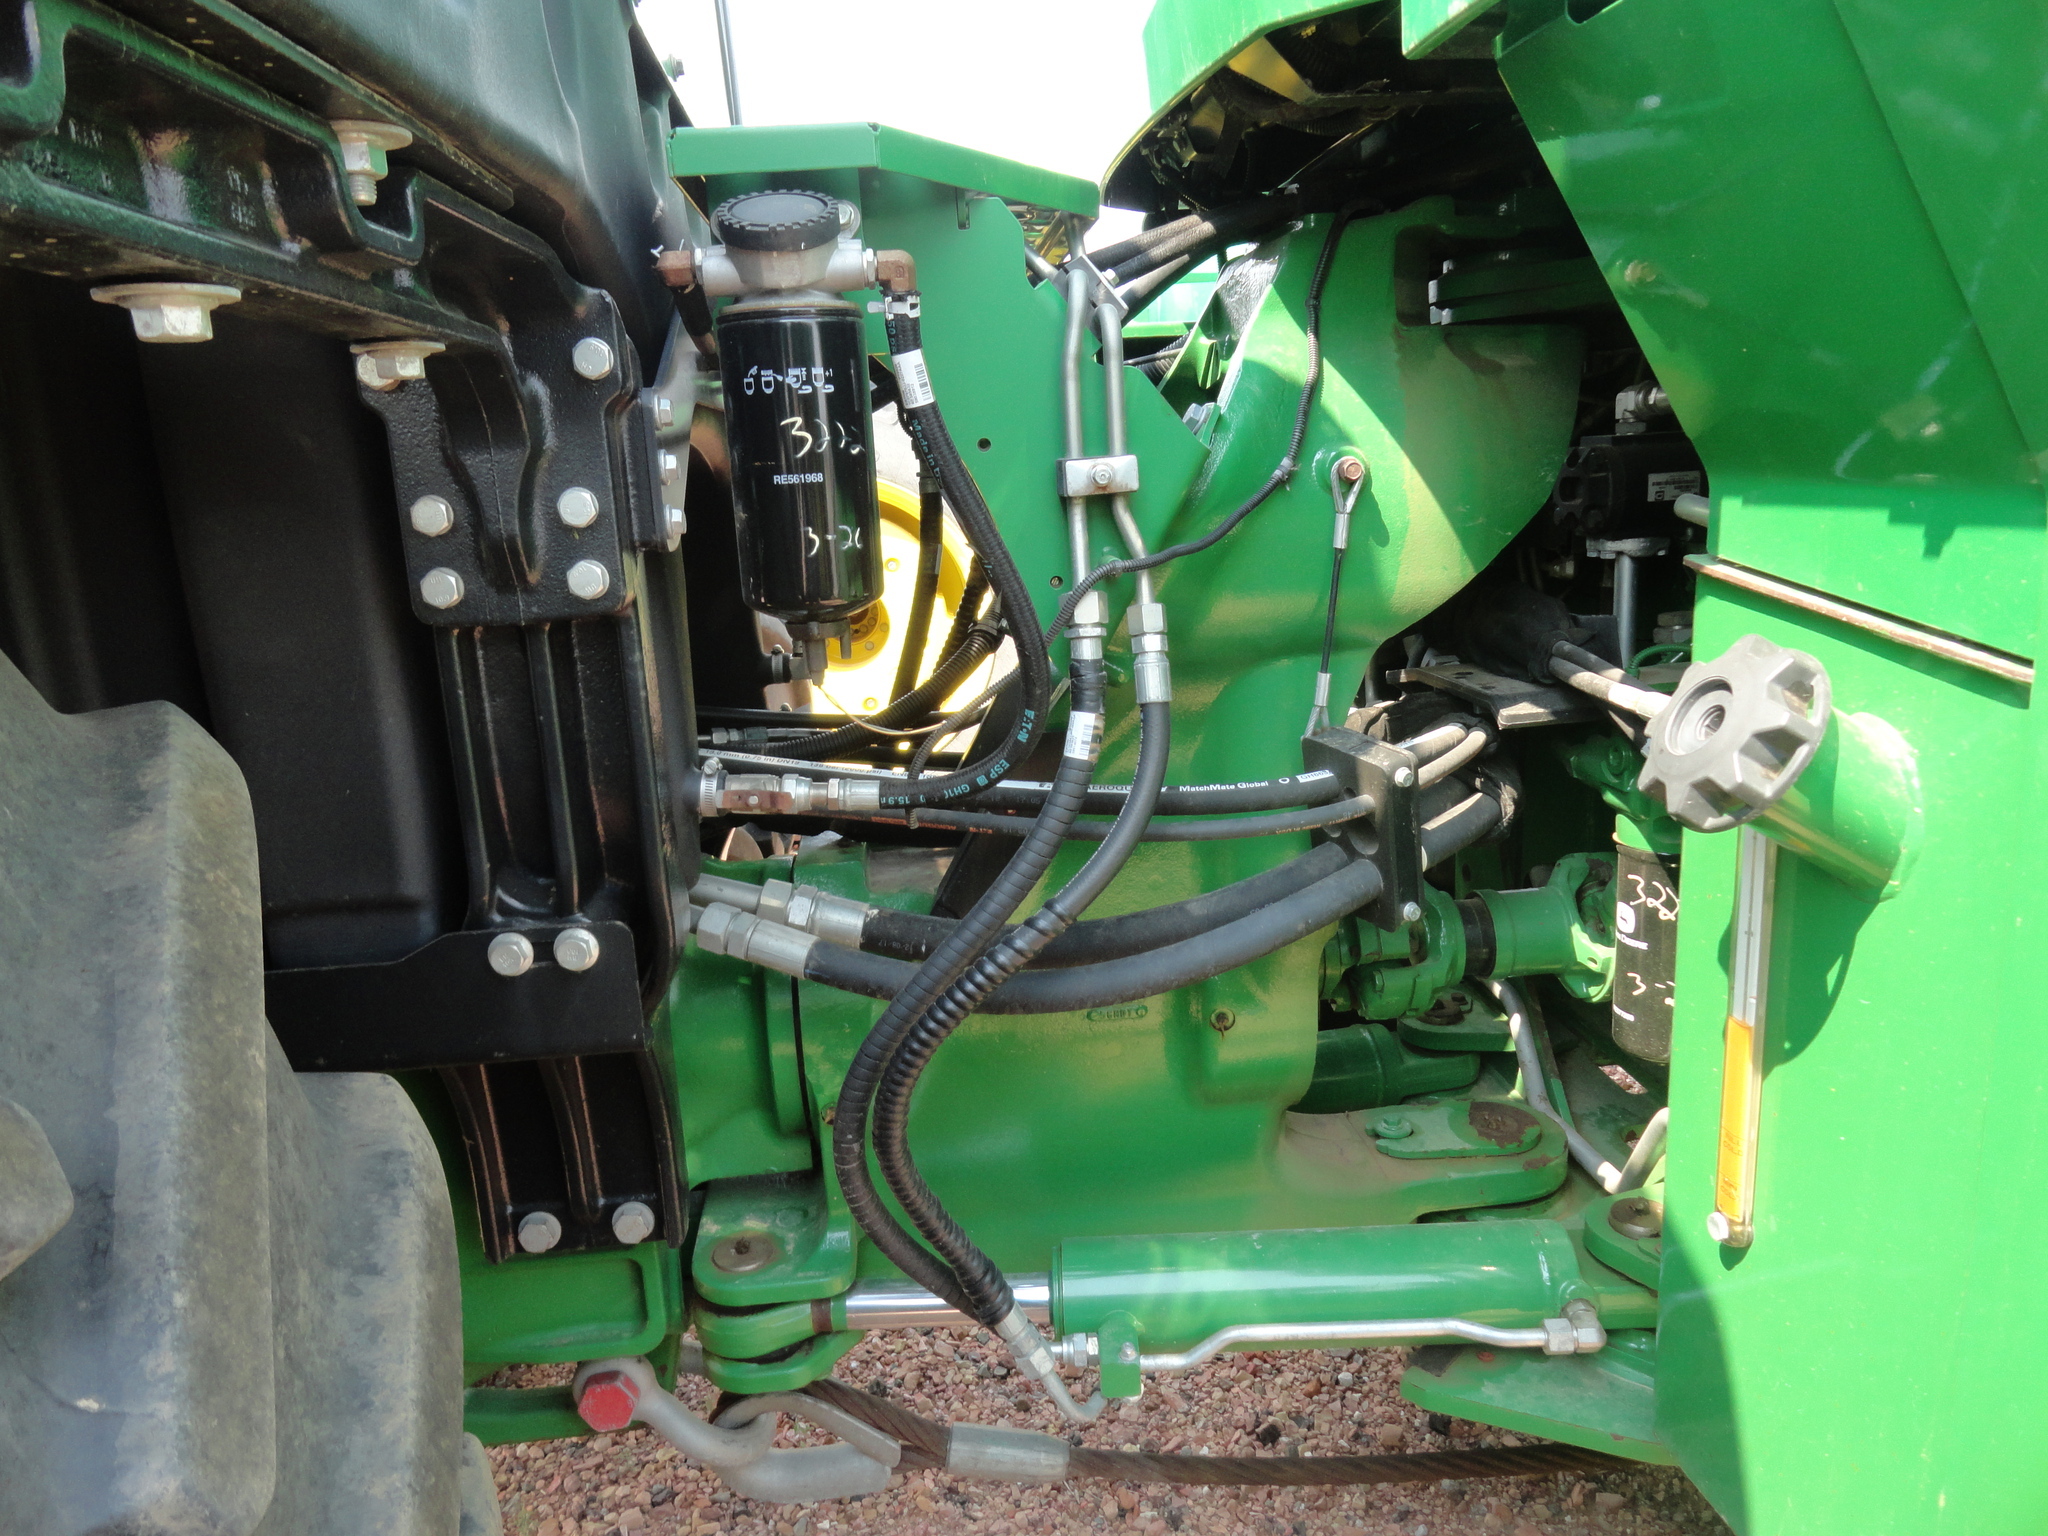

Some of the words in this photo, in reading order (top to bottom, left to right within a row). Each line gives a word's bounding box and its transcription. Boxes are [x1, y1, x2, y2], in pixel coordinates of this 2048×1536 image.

[911, 418, 928, 455] Made
[773, 472, 824, 485] RE561968
[989, 759, 1011, 780] ESP
[1179, 783, 1236, 793] MatchMate
[1236, 780, 1269, 790] Global
[887, 796, 911, 805] 15.9
